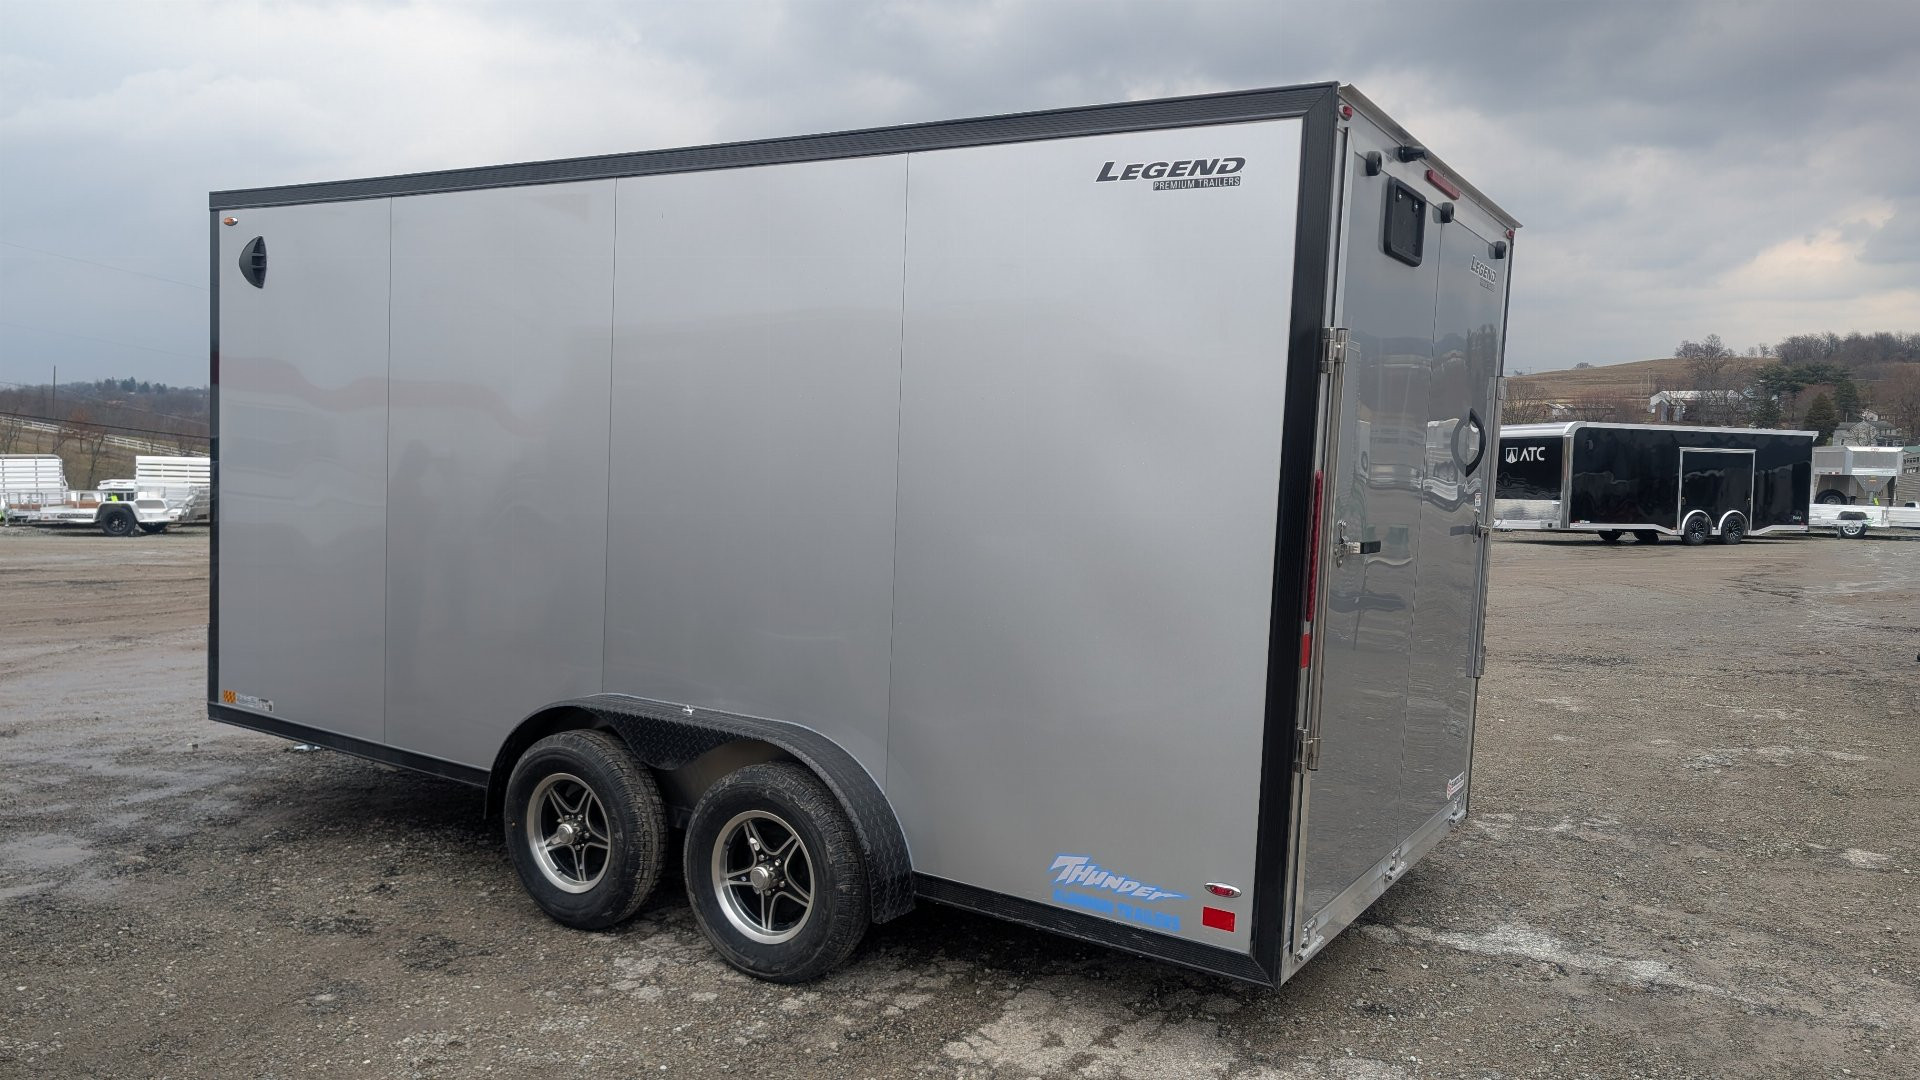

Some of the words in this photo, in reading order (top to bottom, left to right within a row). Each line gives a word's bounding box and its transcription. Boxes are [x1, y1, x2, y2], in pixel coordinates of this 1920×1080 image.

[1096, 157, 1246, 182] LEGEND
[1153, 179, 1195, 190] PREMIUM
[1199, 176, 1241, 187] TRAILERS
[1470, 254, 1497, 284] LEGEND
[1519, 446, 1546, 462] ATC
